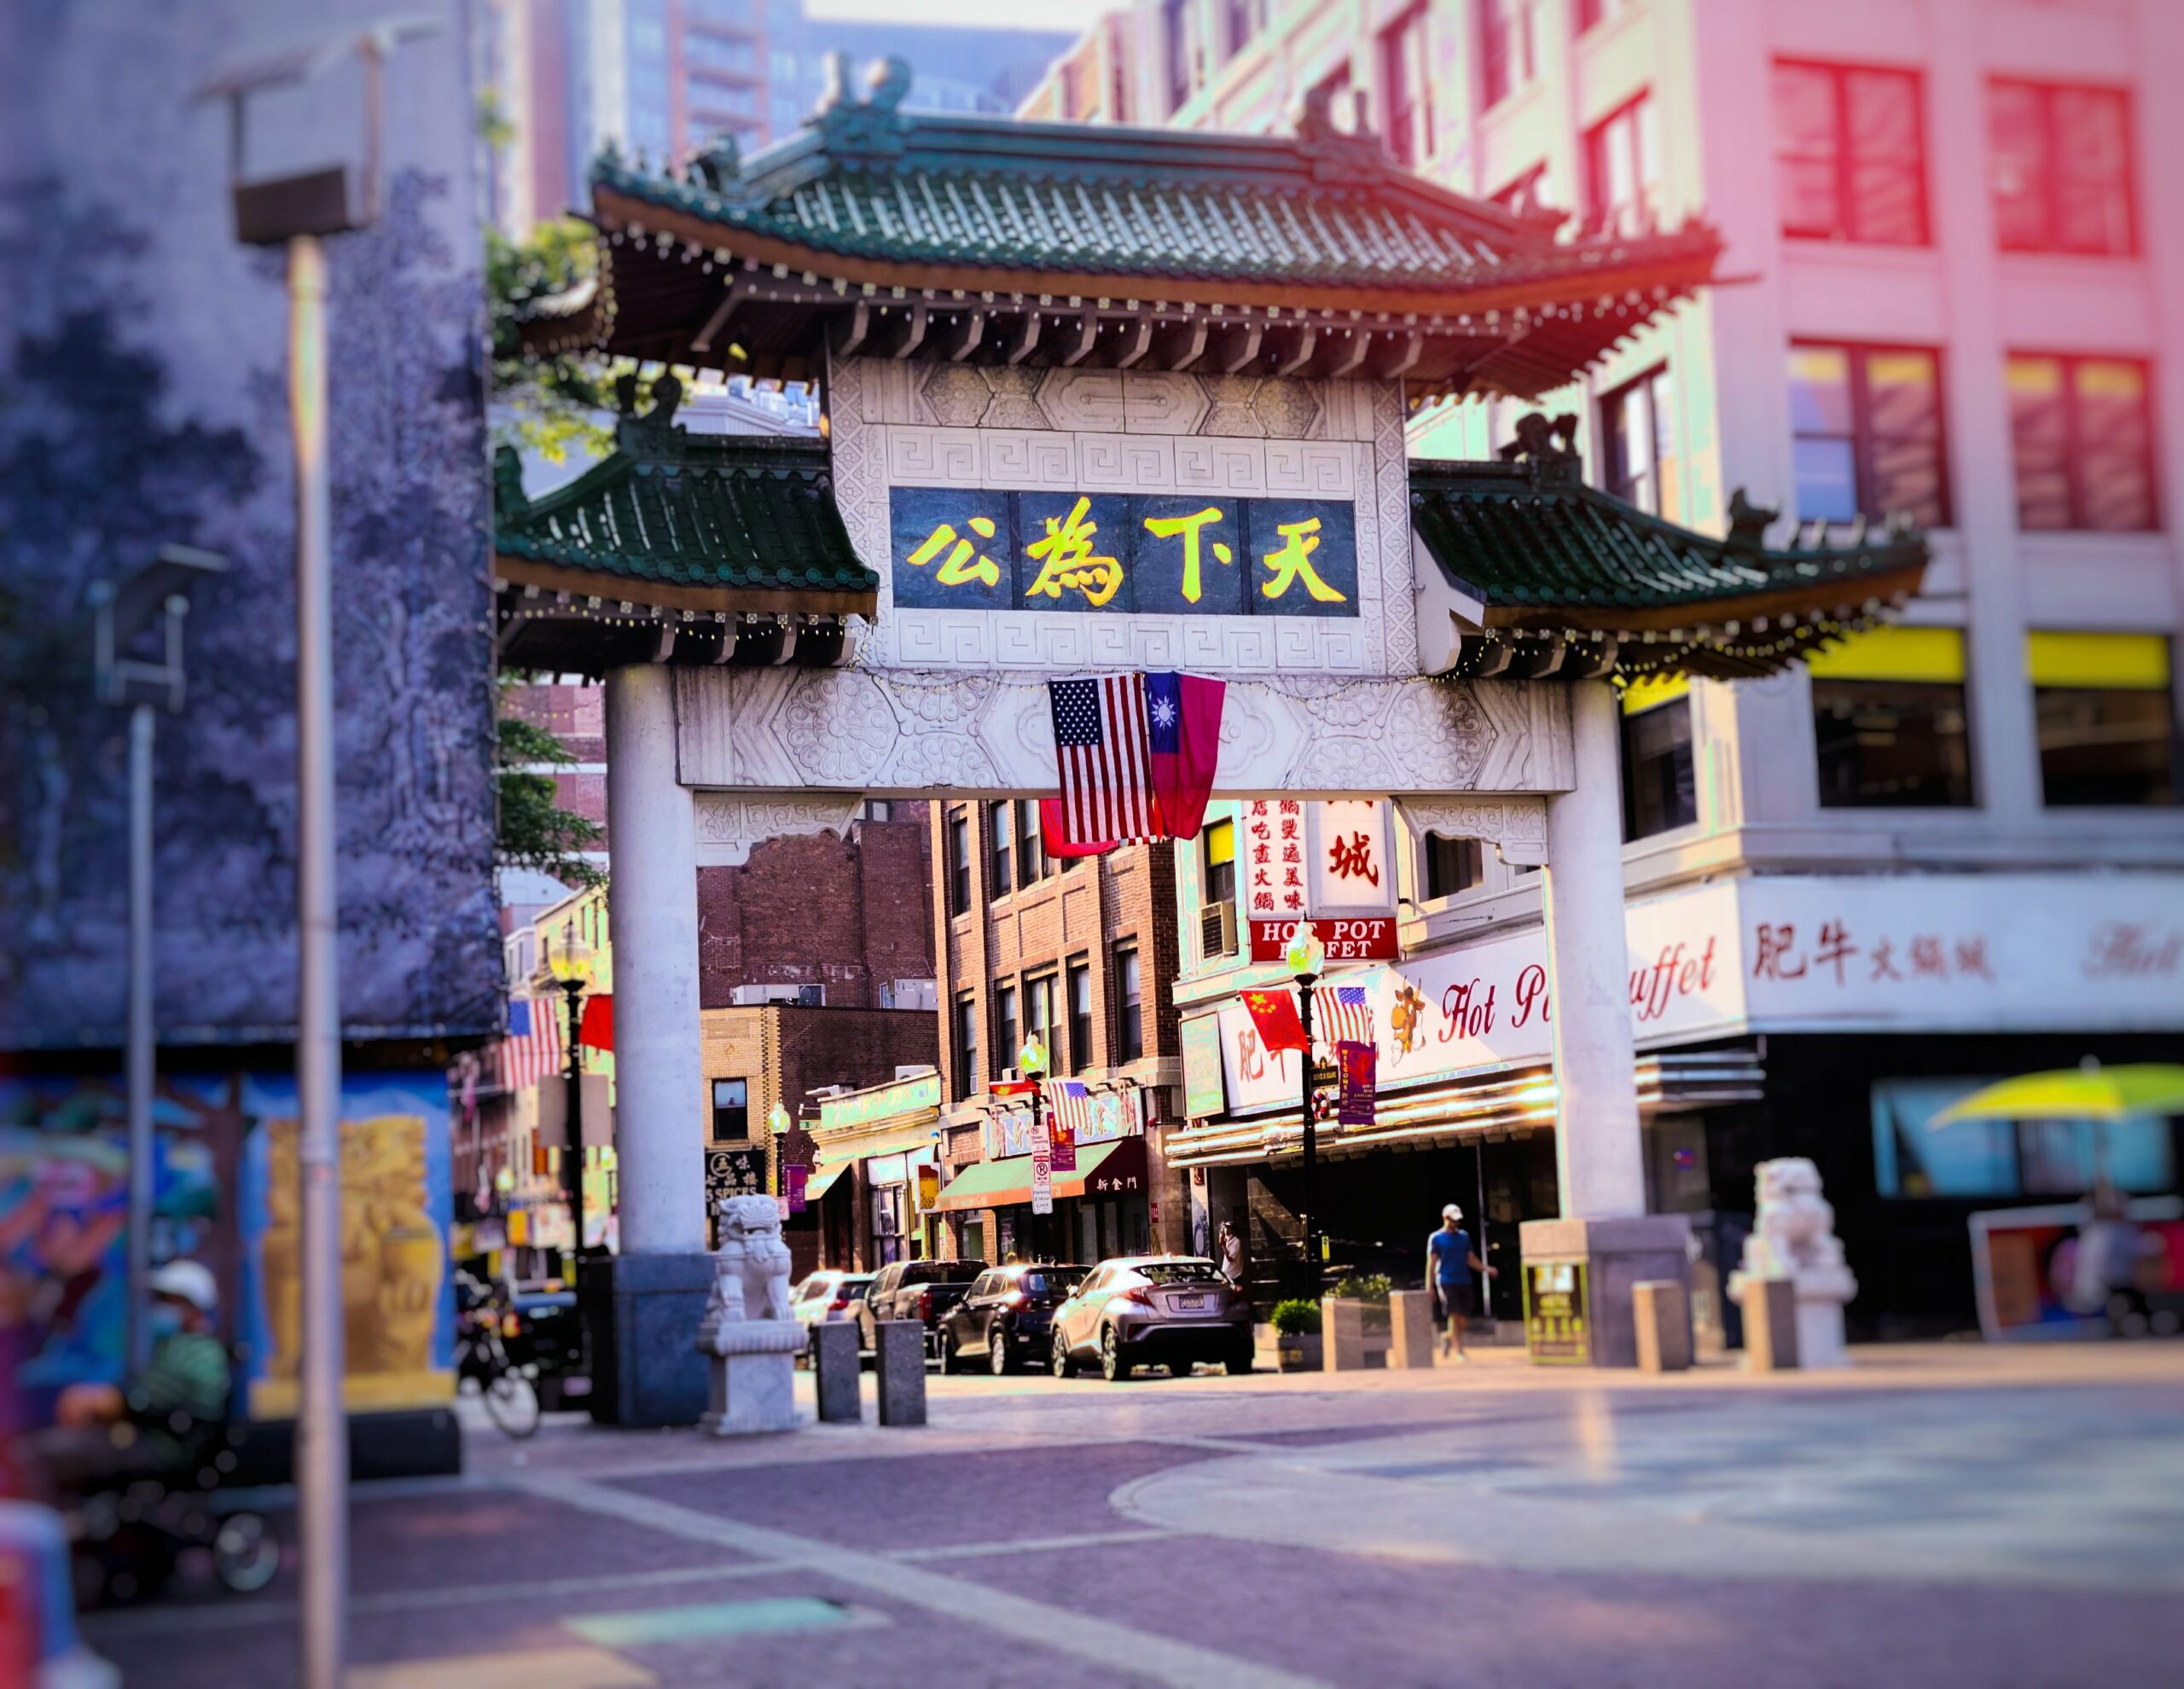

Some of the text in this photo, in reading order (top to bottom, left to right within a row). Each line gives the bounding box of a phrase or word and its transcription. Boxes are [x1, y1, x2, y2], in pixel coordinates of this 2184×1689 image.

[1328, 800, 1380, 887] 城
[1333, 920, 1385, 939] POT
[1438, 978, 1496, 1042] Hot
[1628, 936, 1716, 1022] uffet
